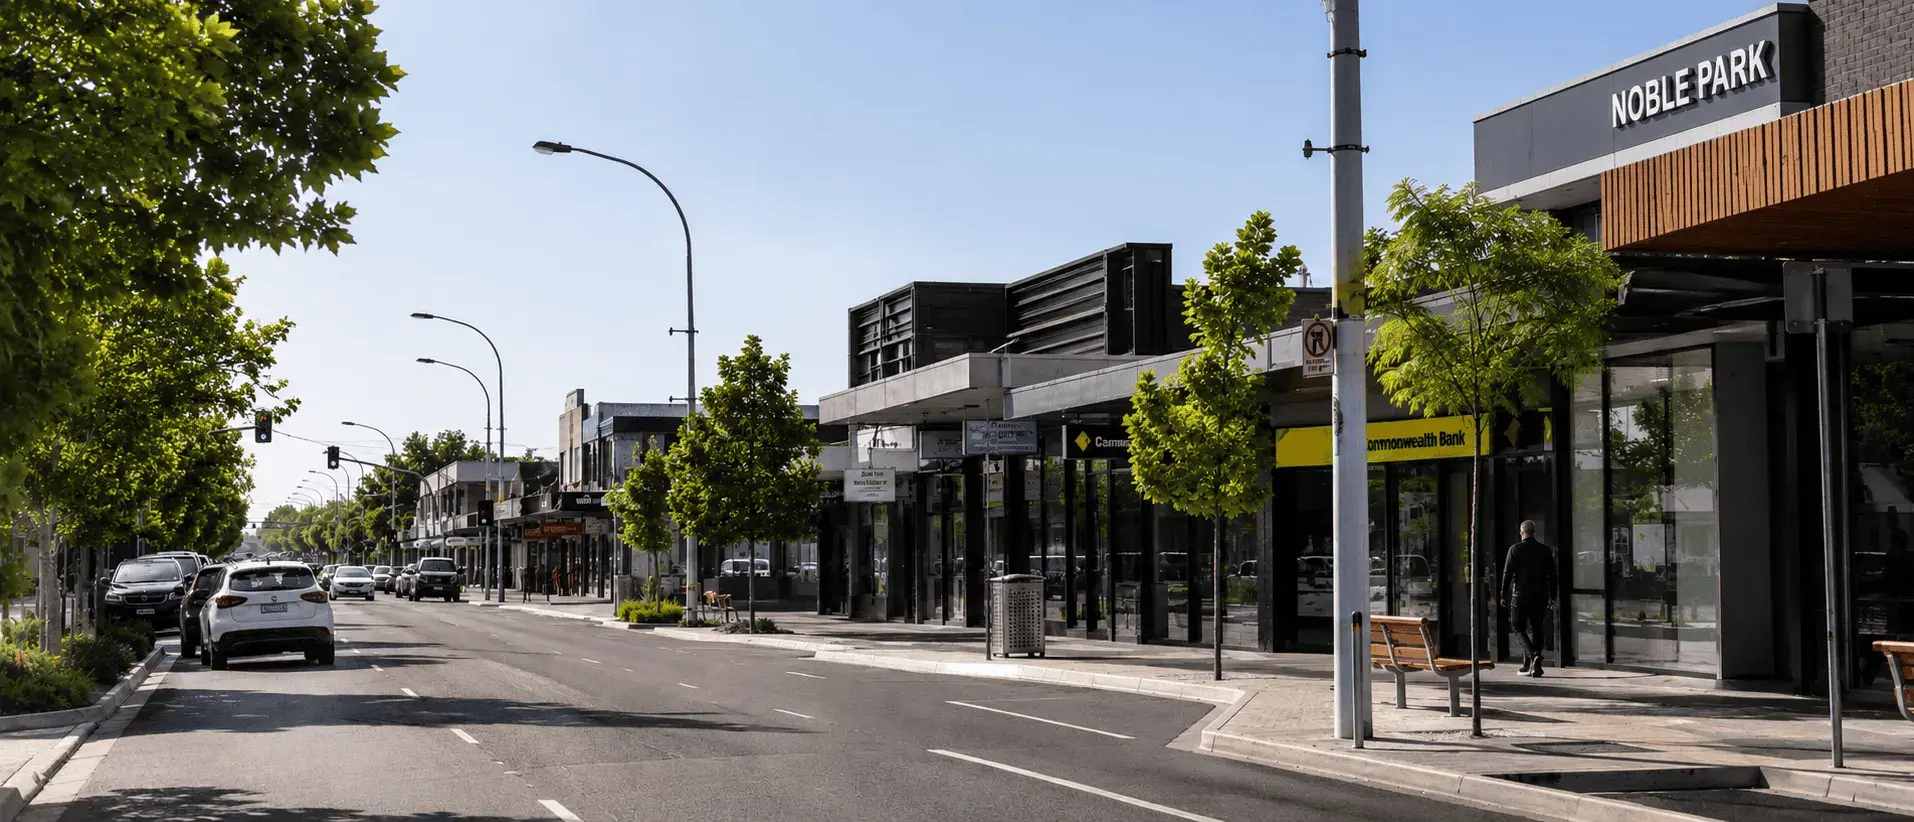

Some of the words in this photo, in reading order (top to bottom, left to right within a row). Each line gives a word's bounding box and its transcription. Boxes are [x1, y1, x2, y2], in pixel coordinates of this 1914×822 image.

[1612, 67, 1690, 128] NOBLE
[1698, 39, 1768, 99] PARK
[1367, 432, 1437, 451] ommonwealth
[1439, 430, 1465, 447] Bank
